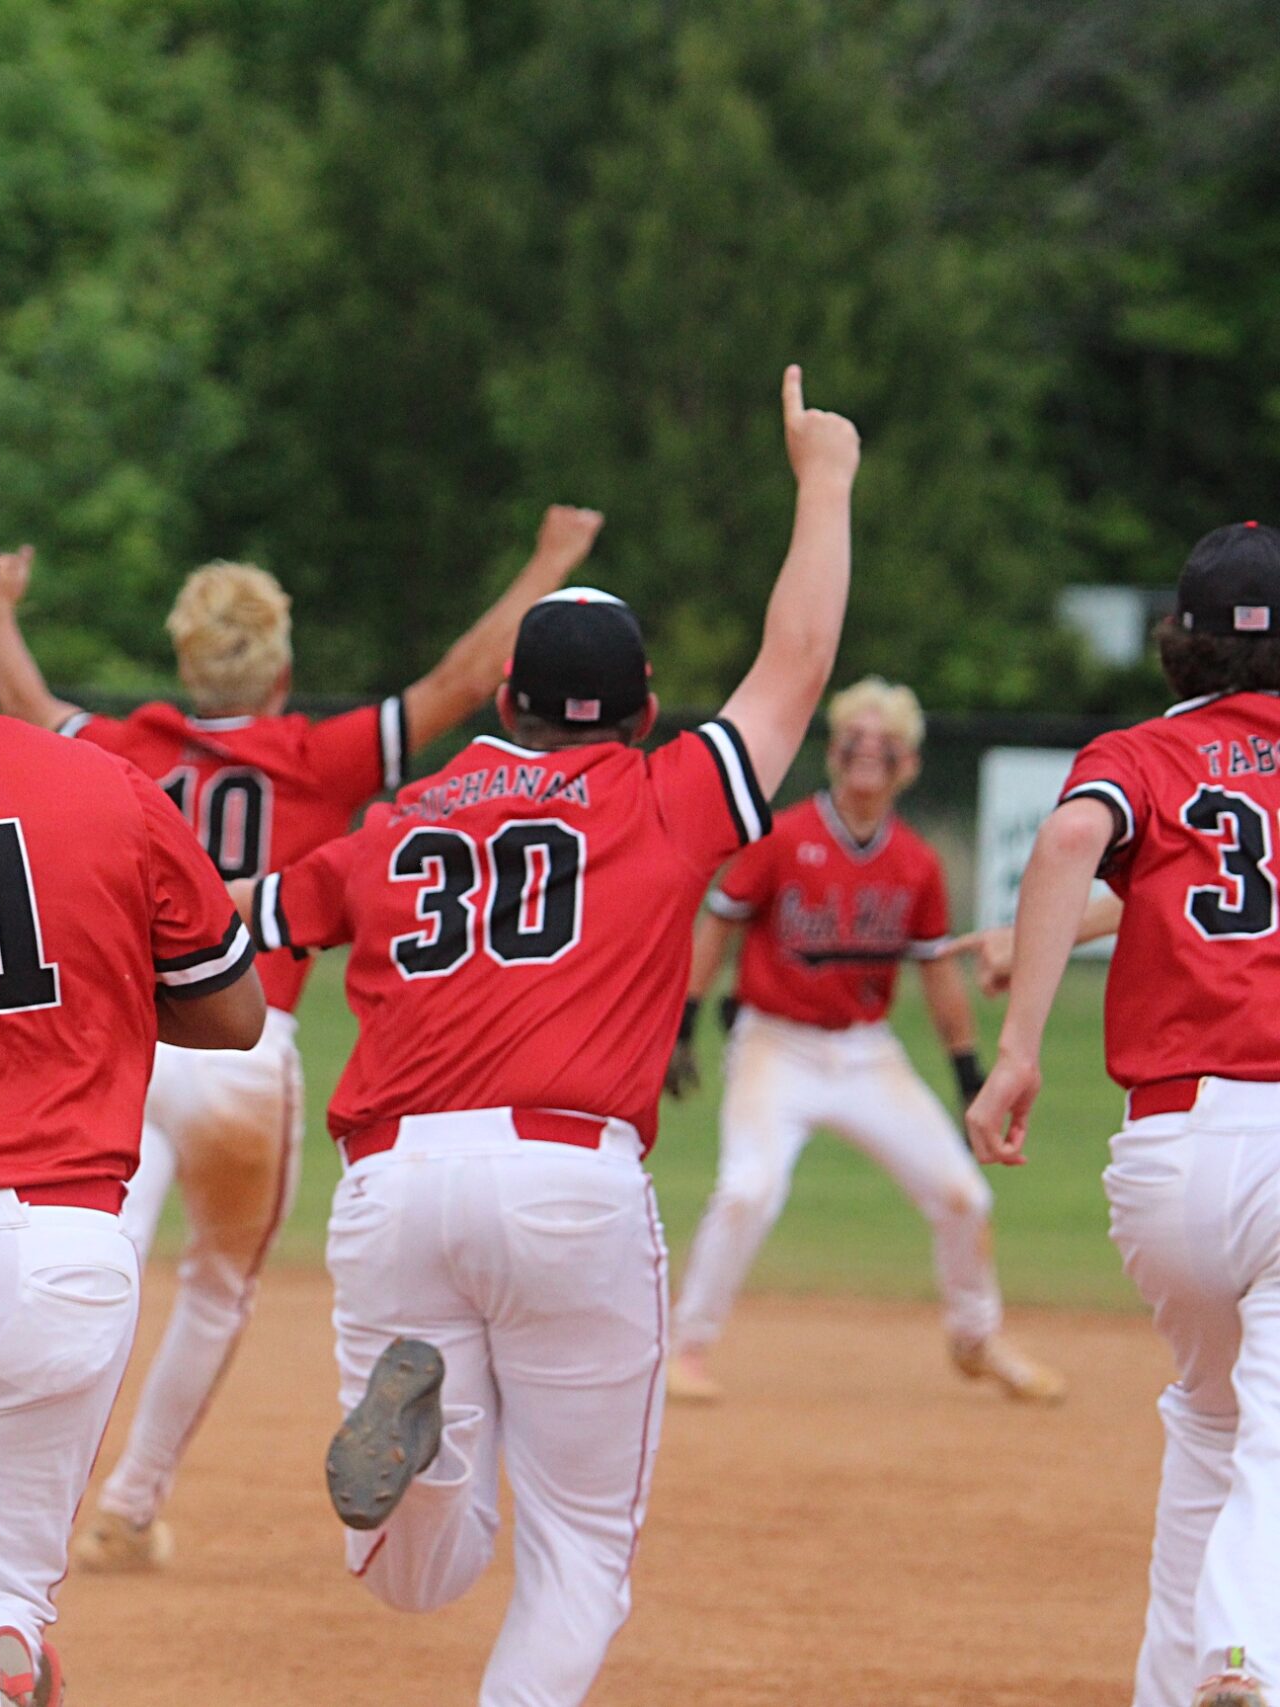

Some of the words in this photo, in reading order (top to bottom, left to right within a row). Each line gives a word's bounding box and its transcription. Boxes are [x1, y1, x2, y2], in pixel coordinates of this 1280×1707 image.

[1199, 734, 1280, 777] TAB
[389, 818, 586, 981] 30
[1179, 782, 1280, 942] 3
